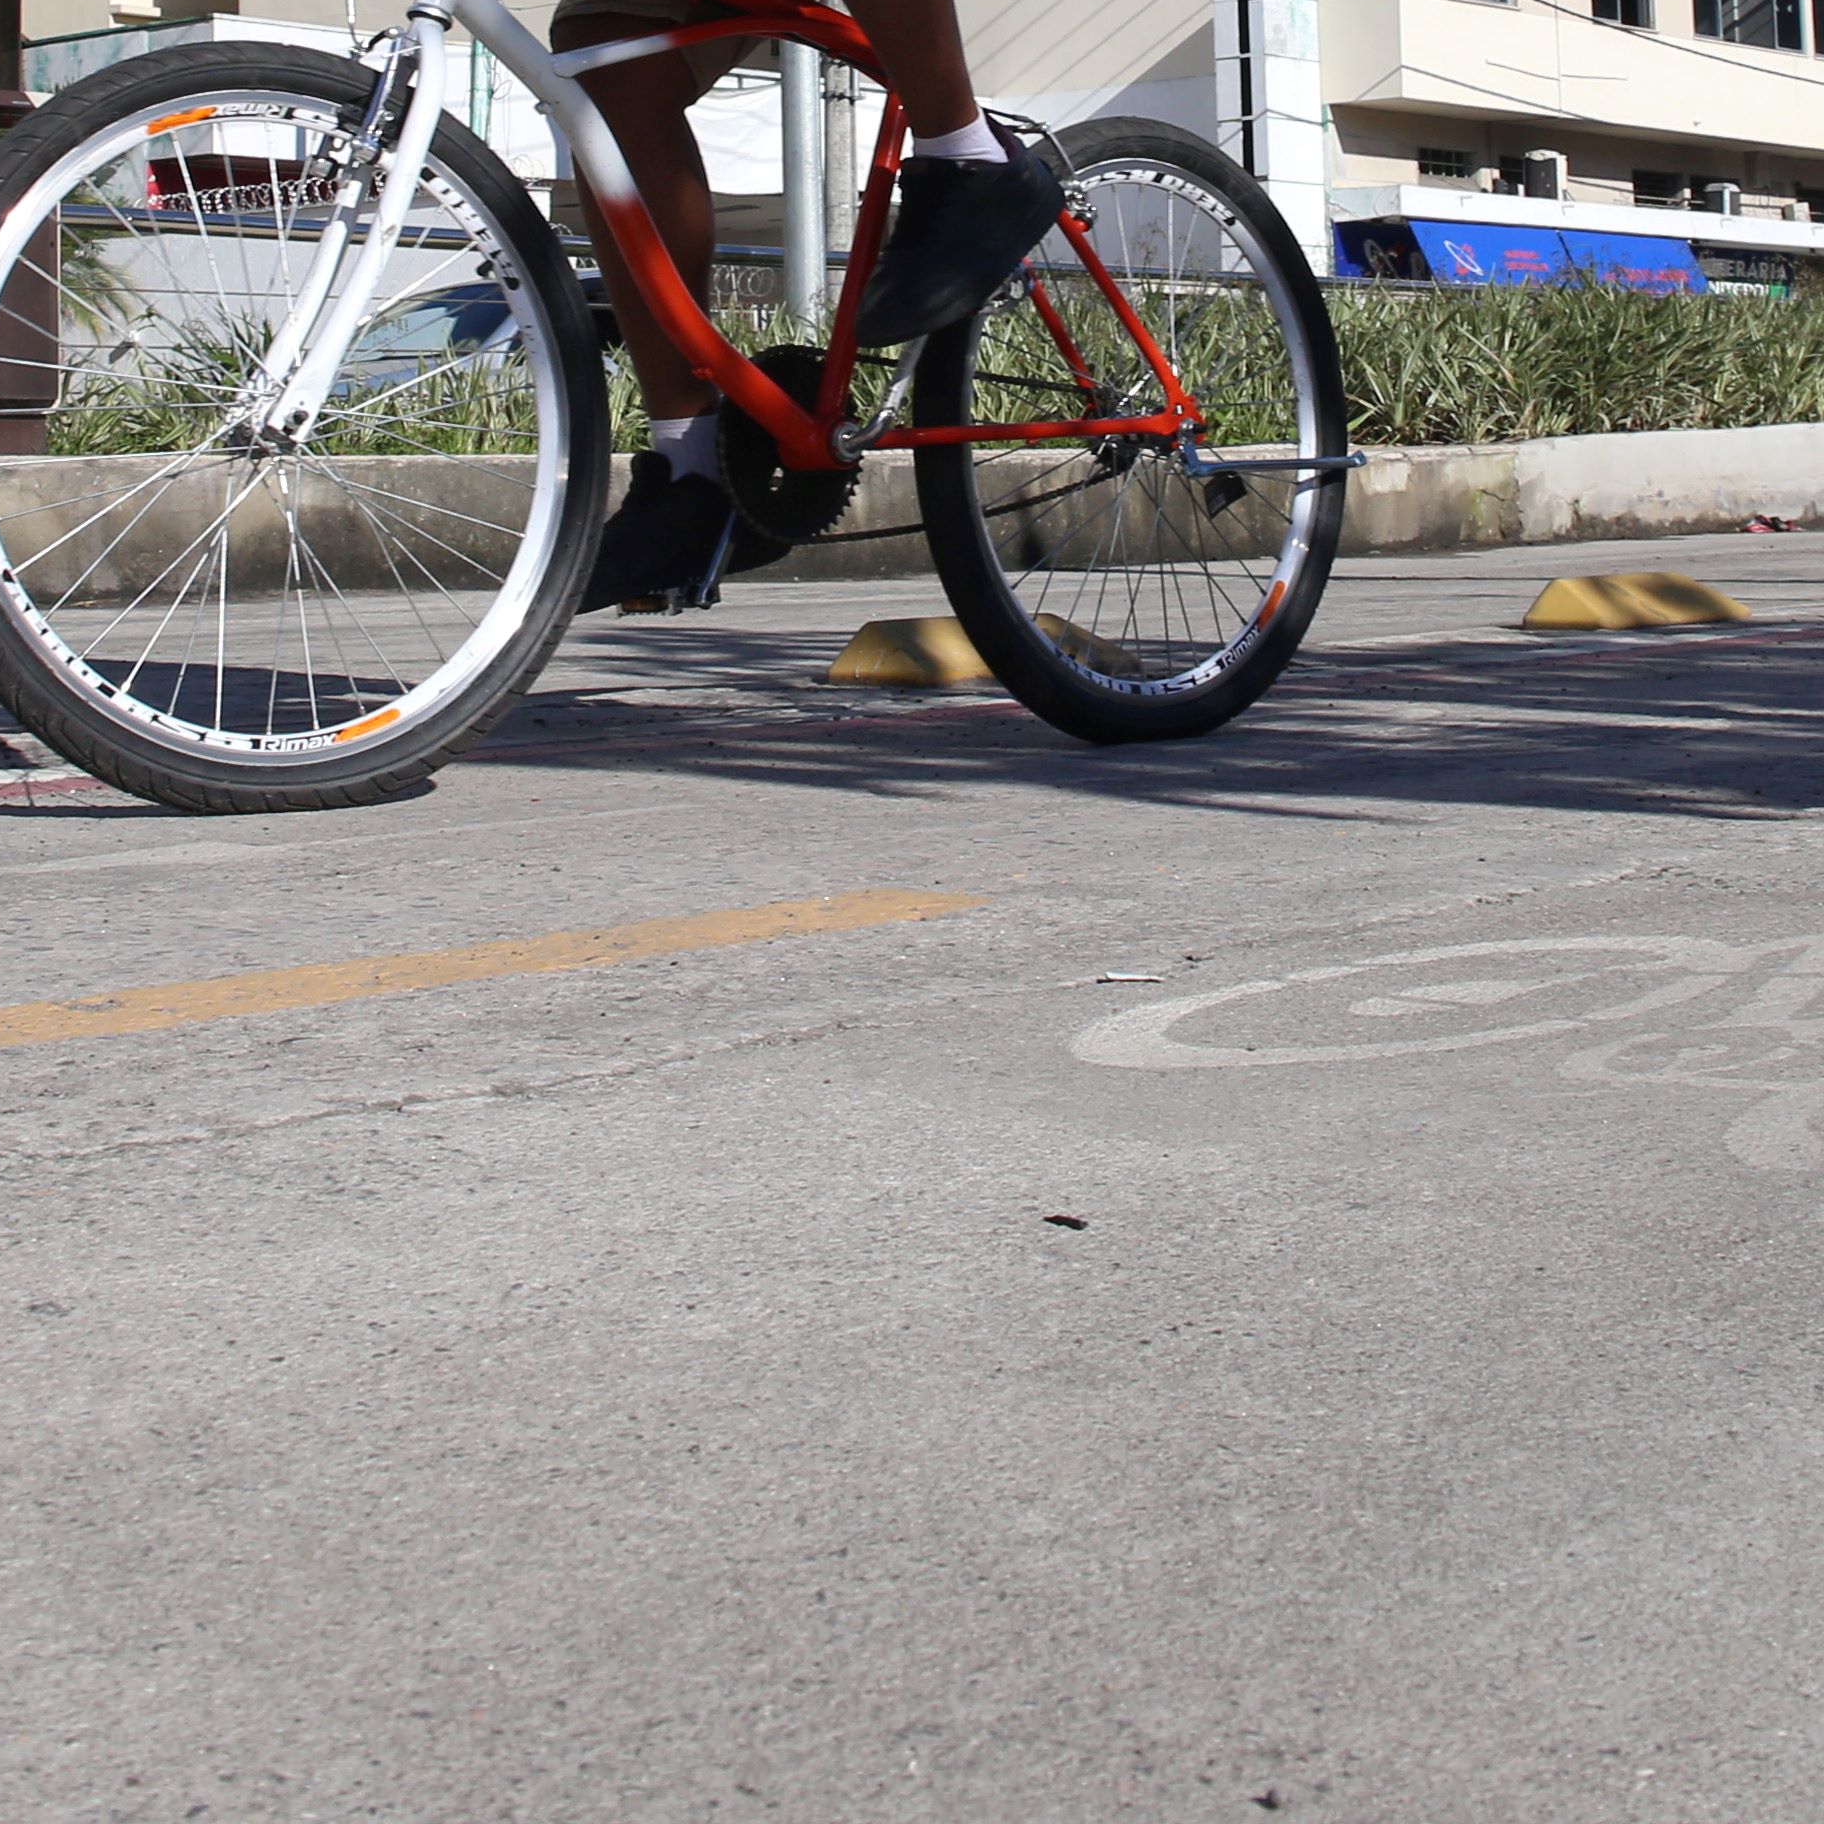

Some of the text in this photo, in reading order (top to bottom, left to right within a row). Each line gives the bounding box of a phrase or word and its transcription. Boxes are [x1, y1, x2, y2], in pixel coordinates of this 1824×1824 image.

[213, 102, 288, 120] Rimax
[1225, 626, 1261, 669] Rimax
[260, 732, 338, 752] Rimax
